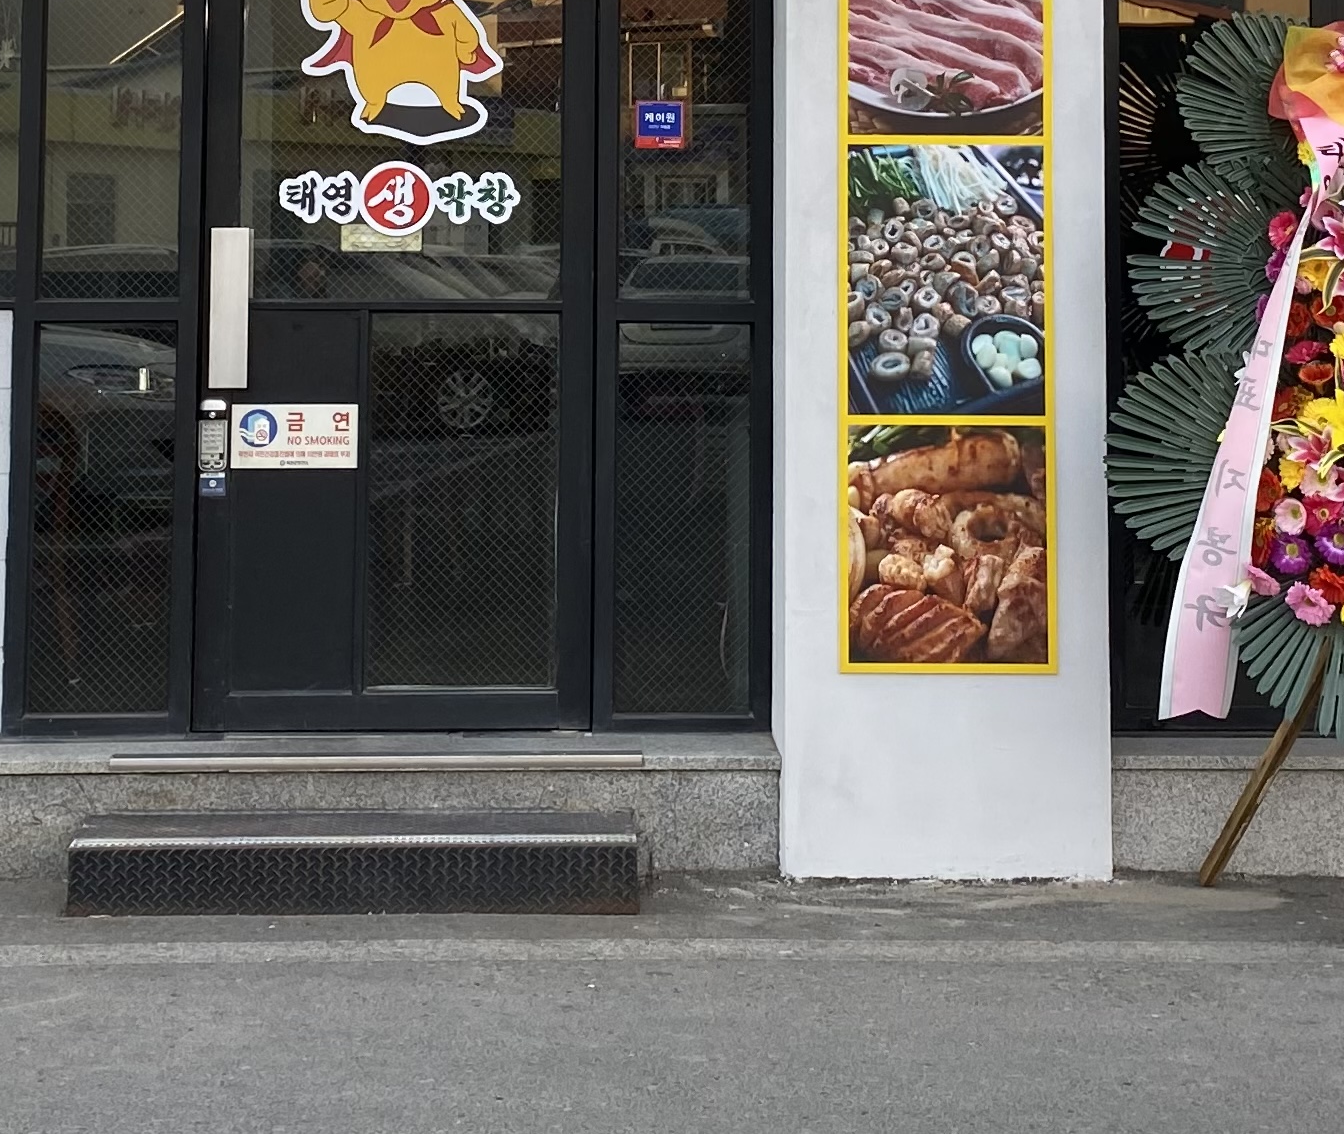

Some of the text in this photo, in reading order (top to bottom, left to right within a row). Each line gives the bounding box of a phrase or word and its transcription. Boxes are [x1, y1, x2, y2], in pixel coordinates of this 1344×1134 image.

[644, 112, 675, 124] 케이원
[287, 171, 514, 226] 태영 생 막창
[287, 436, 350, 445] NO SMOKING
